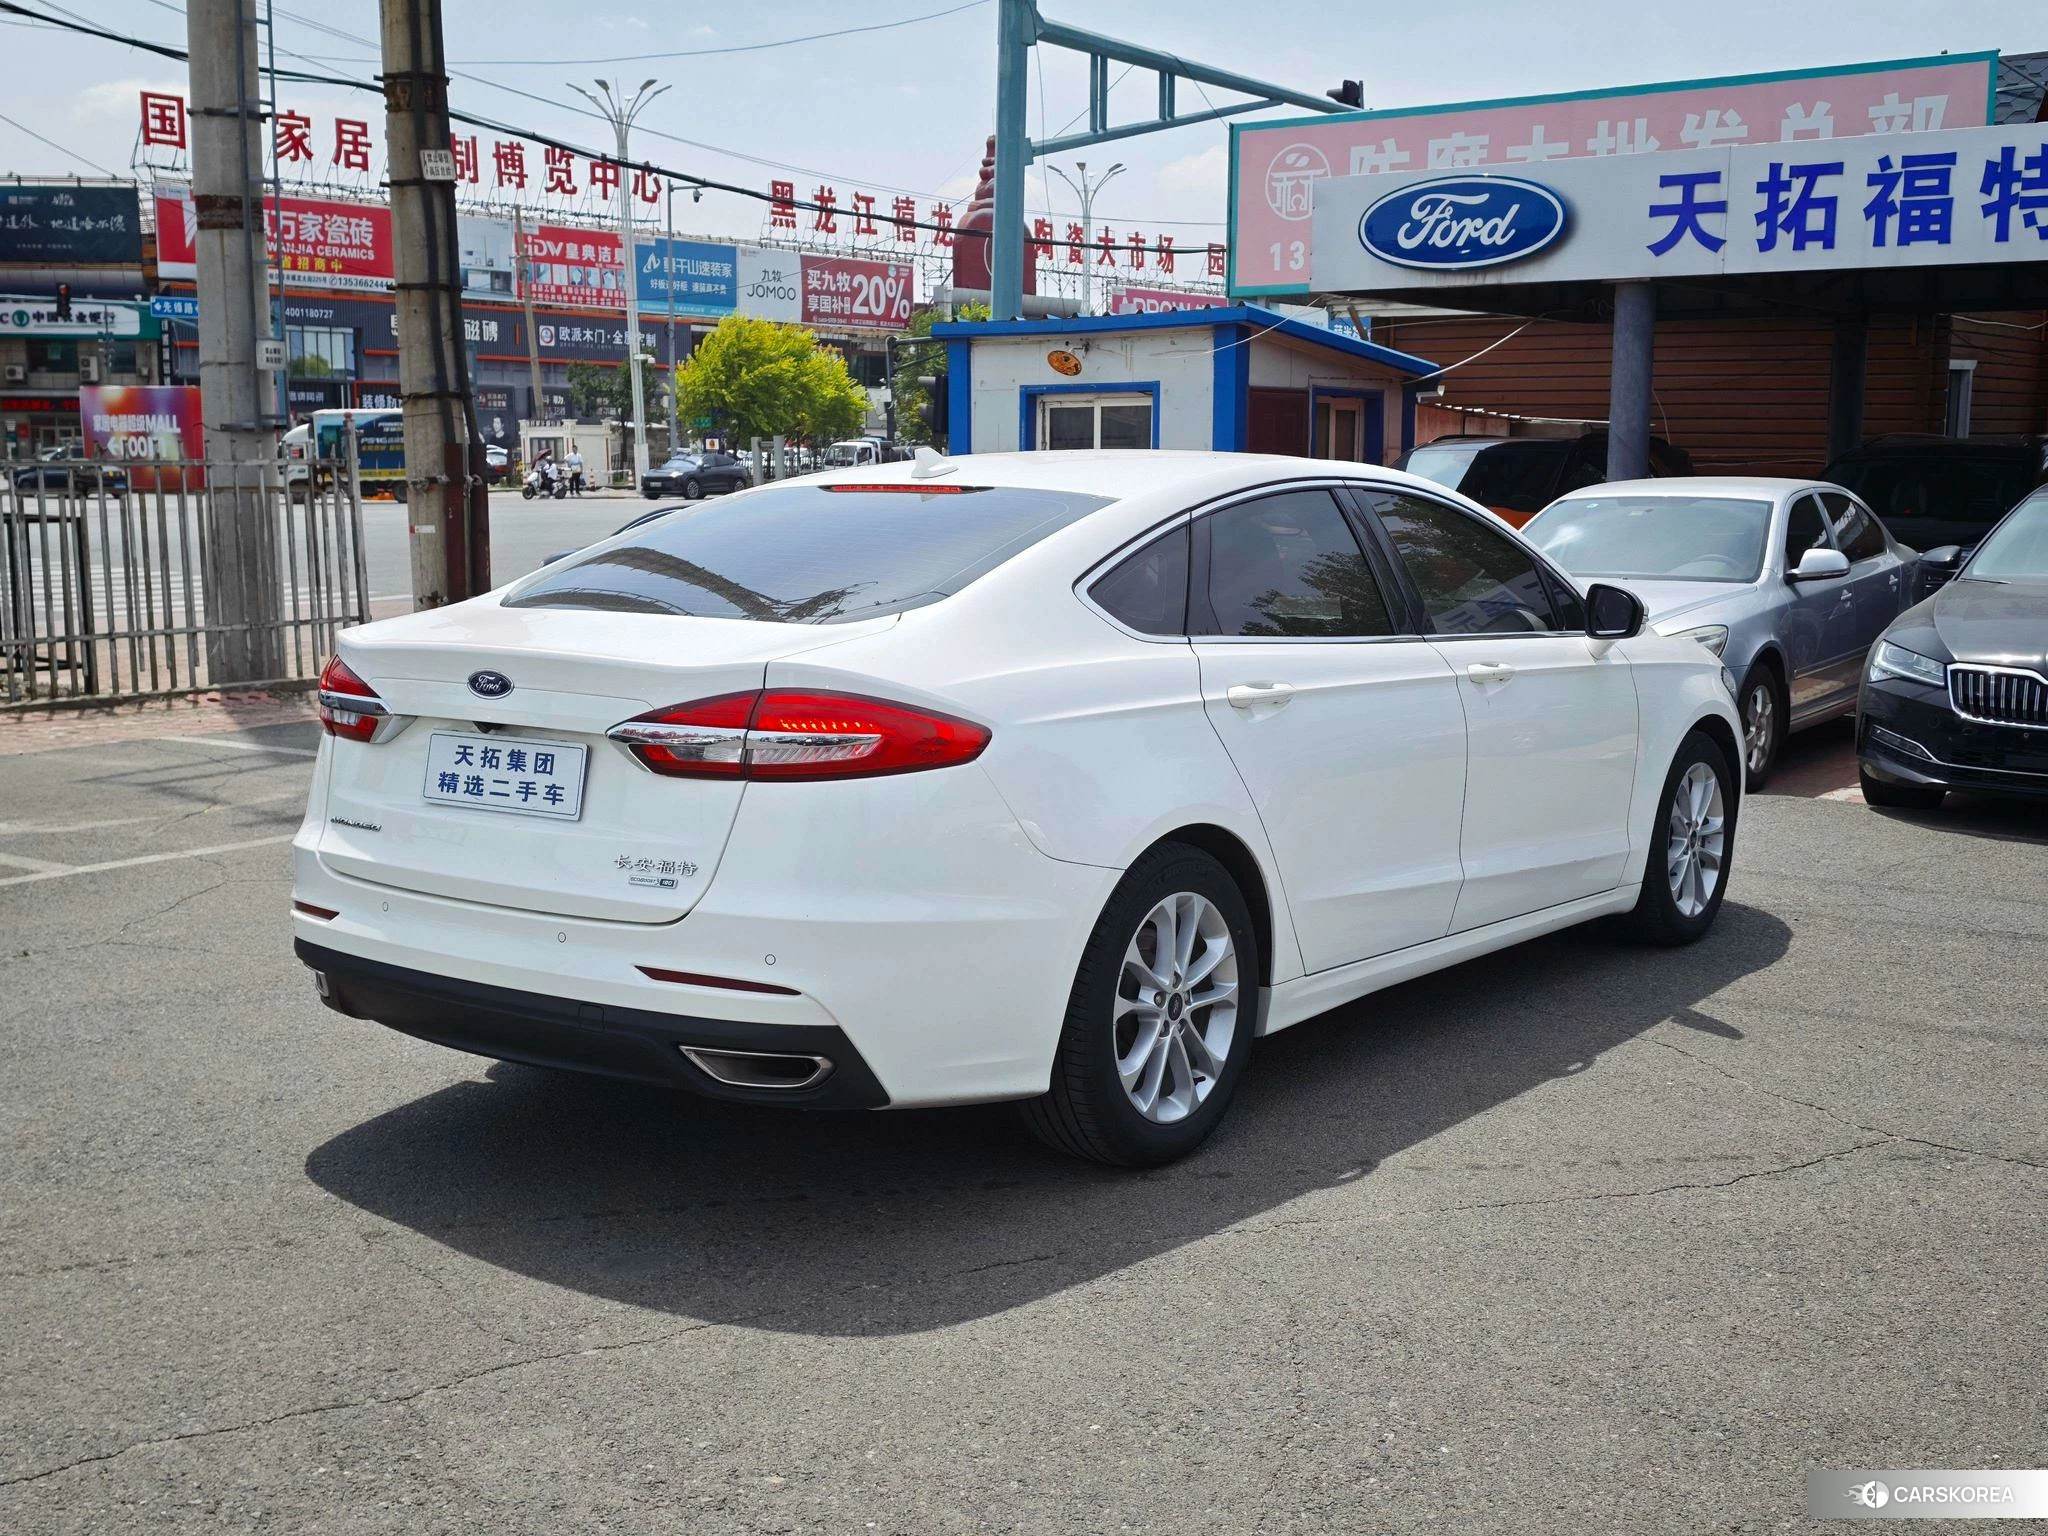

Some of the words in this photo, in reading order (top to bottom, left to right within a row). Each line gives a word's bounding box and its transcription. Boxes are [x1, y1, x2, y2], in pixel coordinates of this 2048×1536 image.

[140, 91, 662, 203] 国家居制博览中心
[1647, 143, 2048, 257] 天拓福特
[1397, 193, 1520, 250] Ford
[267, 254, 343, 272] 省招商中
[317, 247, 375, 261] CERAMICS
[761, 268, 782, 283] 九牧
[807, 269, 851, 293] 买九牧
[747, 284, 797, 301] JOMOO
[852, 273, 910, 320] 20%
[32, 310, 116, 326] 中国业银行
[475, 674, 502, 691] Ford
[454, 744, 555, 775] 天拓集团
[438, 771, 565, 805] 精选二手车
[614, 854, 699, 876] 长安福特
